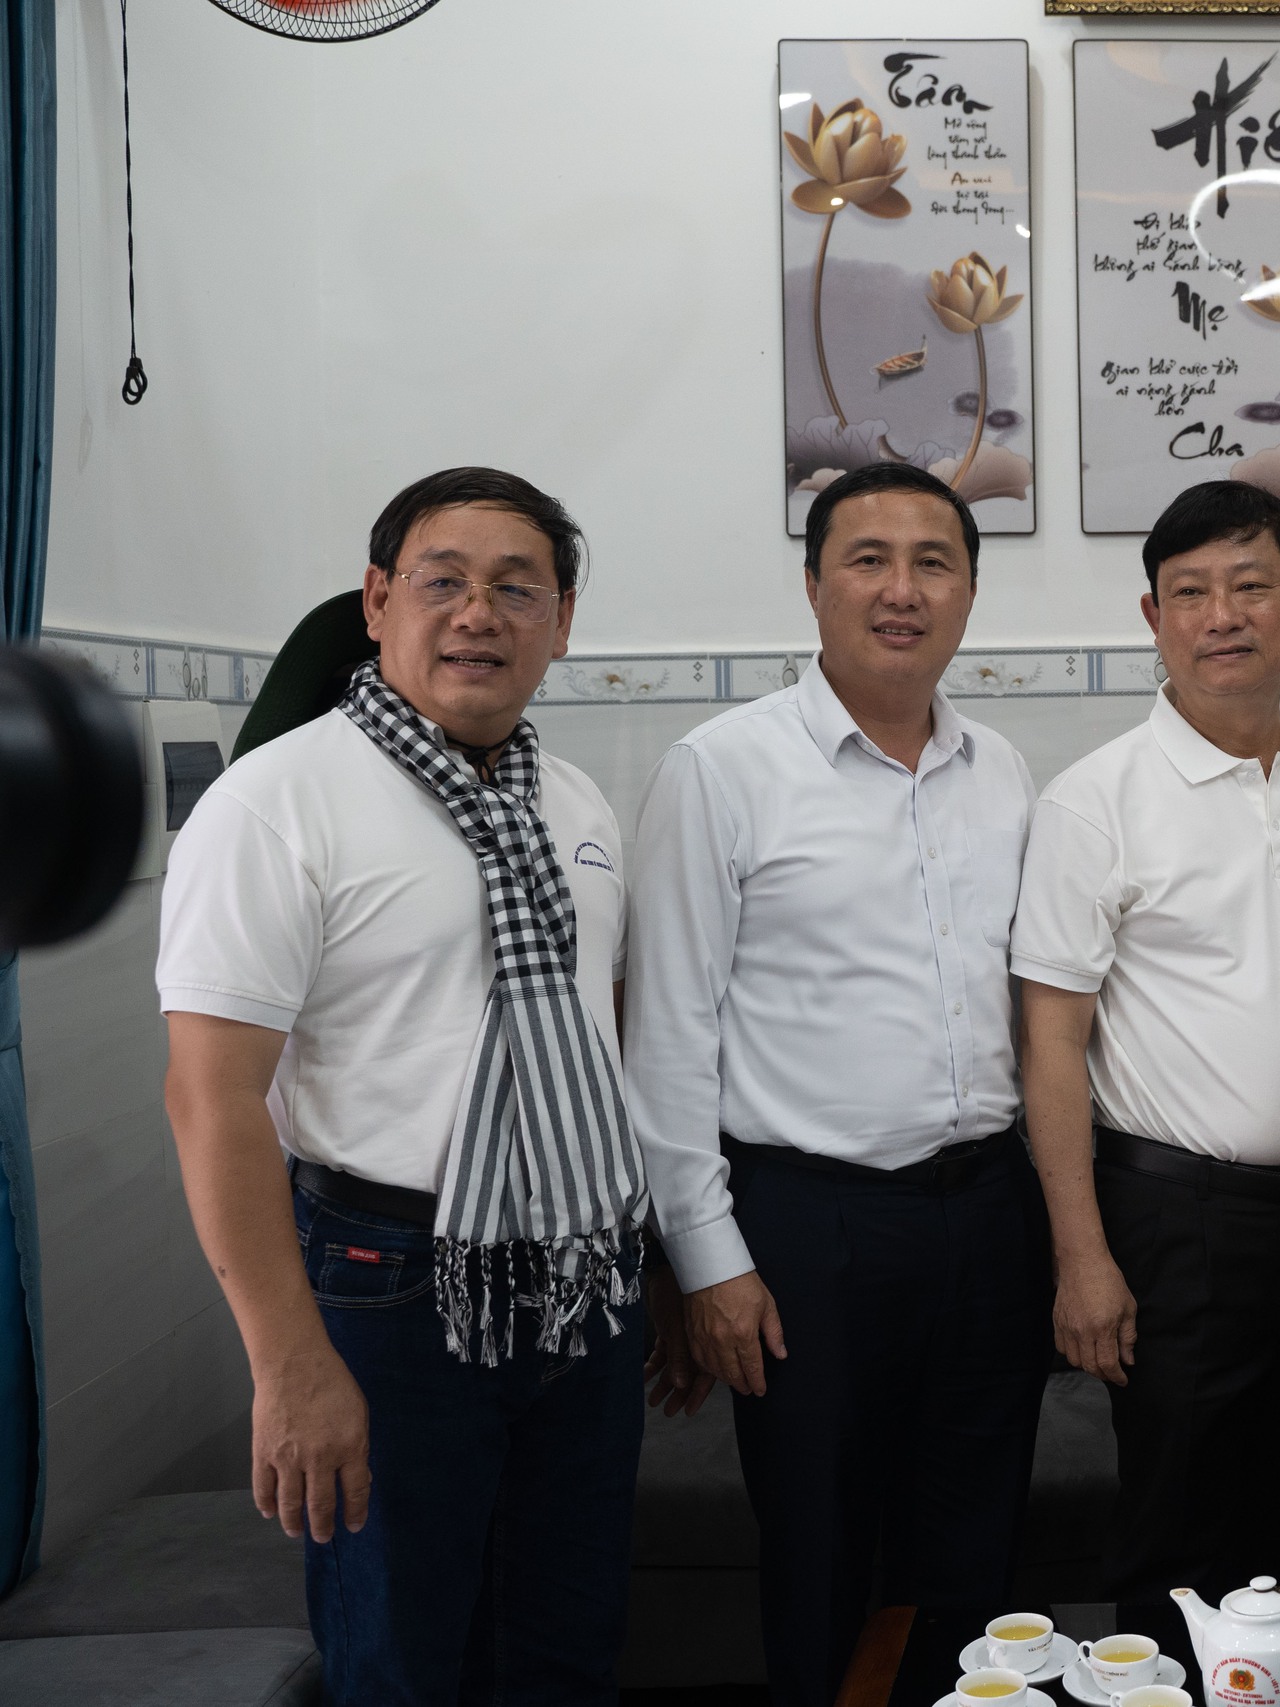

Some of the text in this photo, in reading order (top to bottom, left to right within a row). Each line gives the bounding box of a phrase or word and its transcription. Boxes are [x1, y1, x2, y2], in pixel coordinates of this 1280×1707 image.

[883, 53, 993, 114] Tâm
[951, 172, 968, 186] An
[1171, 280, 1229, 341] Mẹ
[1169, 421, 1244, 460] Cha
